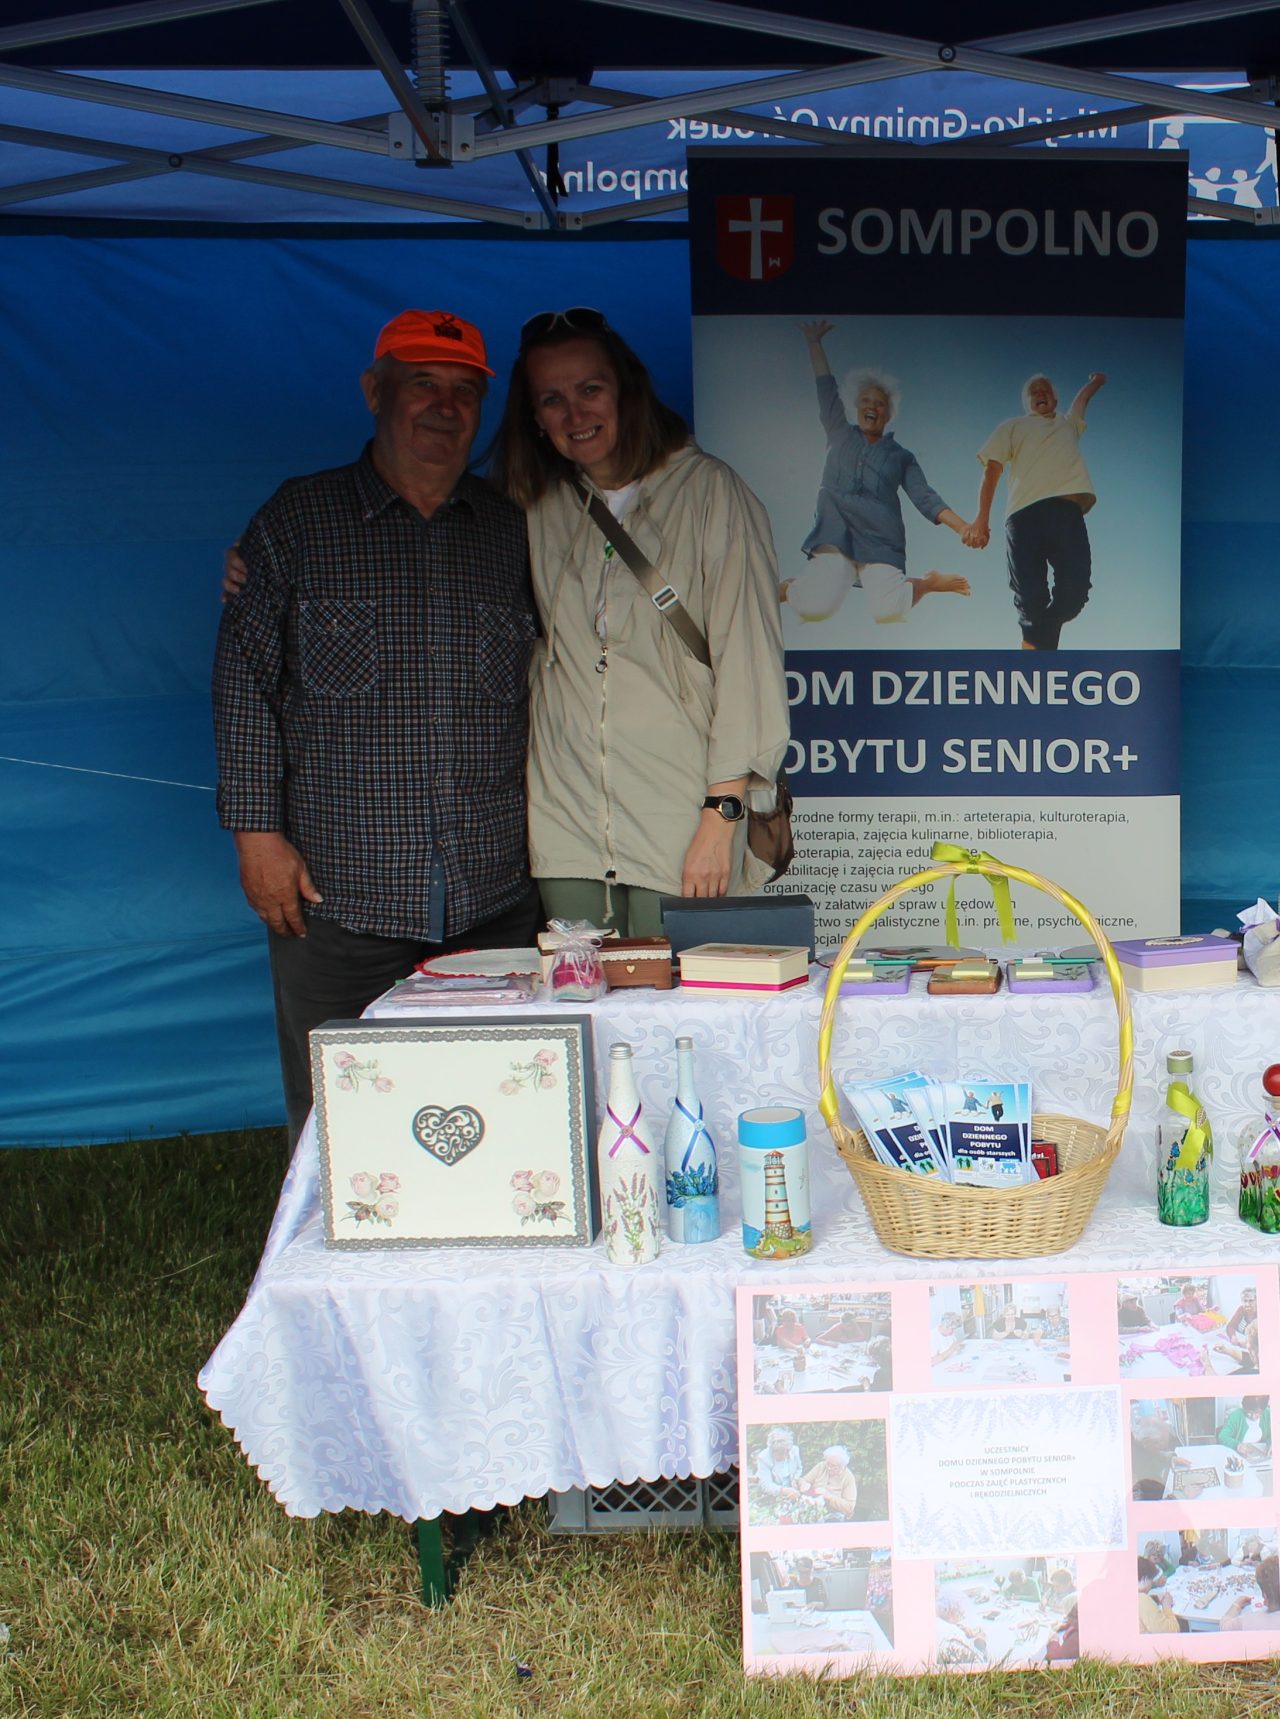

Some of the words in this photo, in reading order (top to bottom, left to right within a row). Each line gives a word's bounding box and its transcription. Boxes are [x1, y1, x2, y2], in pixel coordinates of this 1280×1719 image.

[817, 207, 1159, 258] SOMPOLNO
[784, 671, 854, 705] OM
[872, 670, 1141, 706] DZIENNEGO
[784, 738, 927, 774] OBYTU
[942, 738, 1138, 774] SENIOR+
[791, 811, 834, 823] orodne
[838, 811, 874, 826] formy
[878, 812, 920, 826] terapii,
[963, 811, 1035, 825] arteterapia,
[1039, 811, 1129, 825] kulturoterapia,
[791, 829, 859, 842] ykoterapia,
[863, 830, 907, 843] zajęcia
[911, 829, 973, 842] kulinarne,
[977, 828, 1057, 841] biblioterapia,
[793, 847, 854, 860] eoterapia,
[858, 847, 901, 860] zajęcia
[785, 865, 839, 878] abilitację
[843, 865, 847, 875] i
[850, 865, 894, 878] zajęcia
[763, 882, 836, 895] organizację
[840, 884, 877, 893] czasu
[825, 899, 895, 910] załatwiau
[898, 900, 937, 912] spraw
[983, 917, 1033, 929] prane,
[974, 1125, 995, 1133] DOM
[962, 1133, 1008, 1141] DZIENNEGO
[970, 1141, 1002, 1149] POBYTU
[984, 1446, 1029, 1455] UCZESTNICY
[938, 1459, 964, 1468] DOMU
[965, 1457, 1009, 1466] DZIENNEGO
[1011, 1456, 1042, 1465] POBYTU
[989, 1467, 1035, 1476] SOMPOLNIE
[949, 1480, 985, 1488] PODCZAS
[986, 1477, 1008, 1488] ZAJĘĆ
[1009, 1476, 1067, 1486] PLASTYCZNYCH
[974, 1488, 1047, 1499] RĘKODZIELNICZYCH
